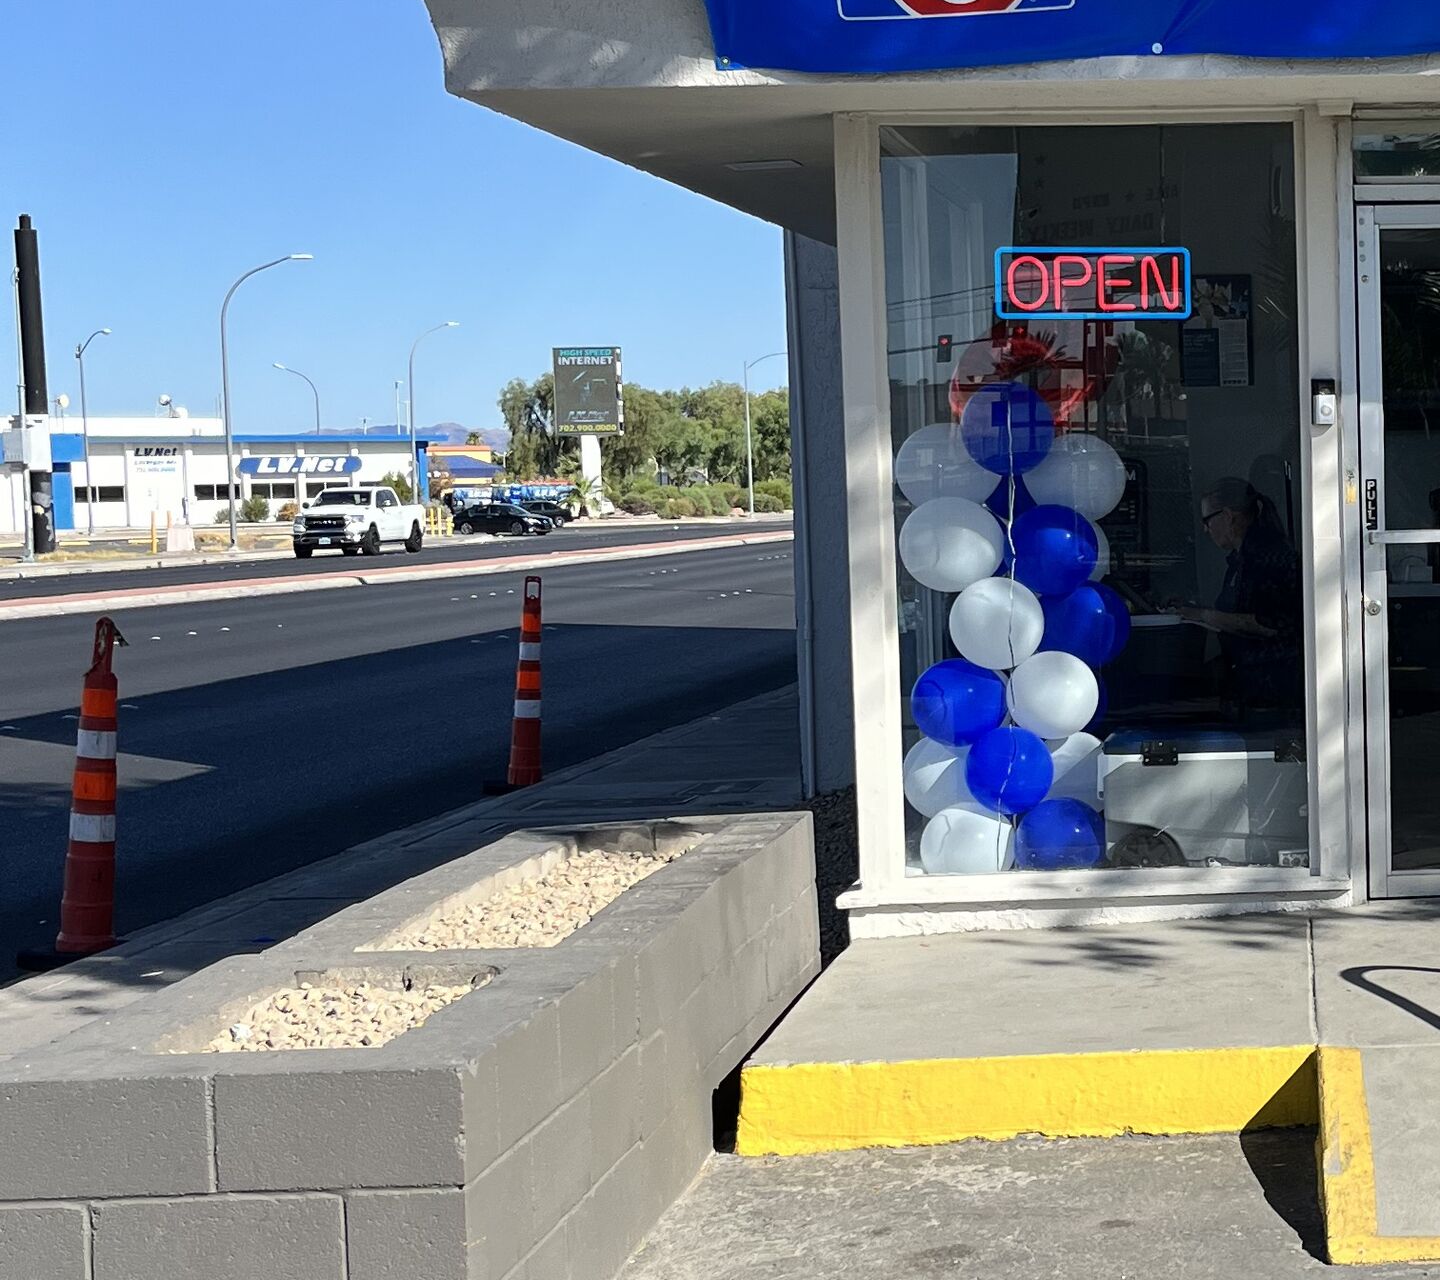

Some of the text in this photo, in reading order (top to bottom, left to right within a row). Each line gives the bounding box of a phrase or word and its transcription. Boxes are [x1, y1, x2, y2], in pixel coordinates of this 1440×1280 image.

[1007, 255, 1179, 311] OPEN
[558, 356, 613, 366] INTERNET
[257, 456, 347, 473] LV.Net
[1367, 480, 1376, 520] PULL
